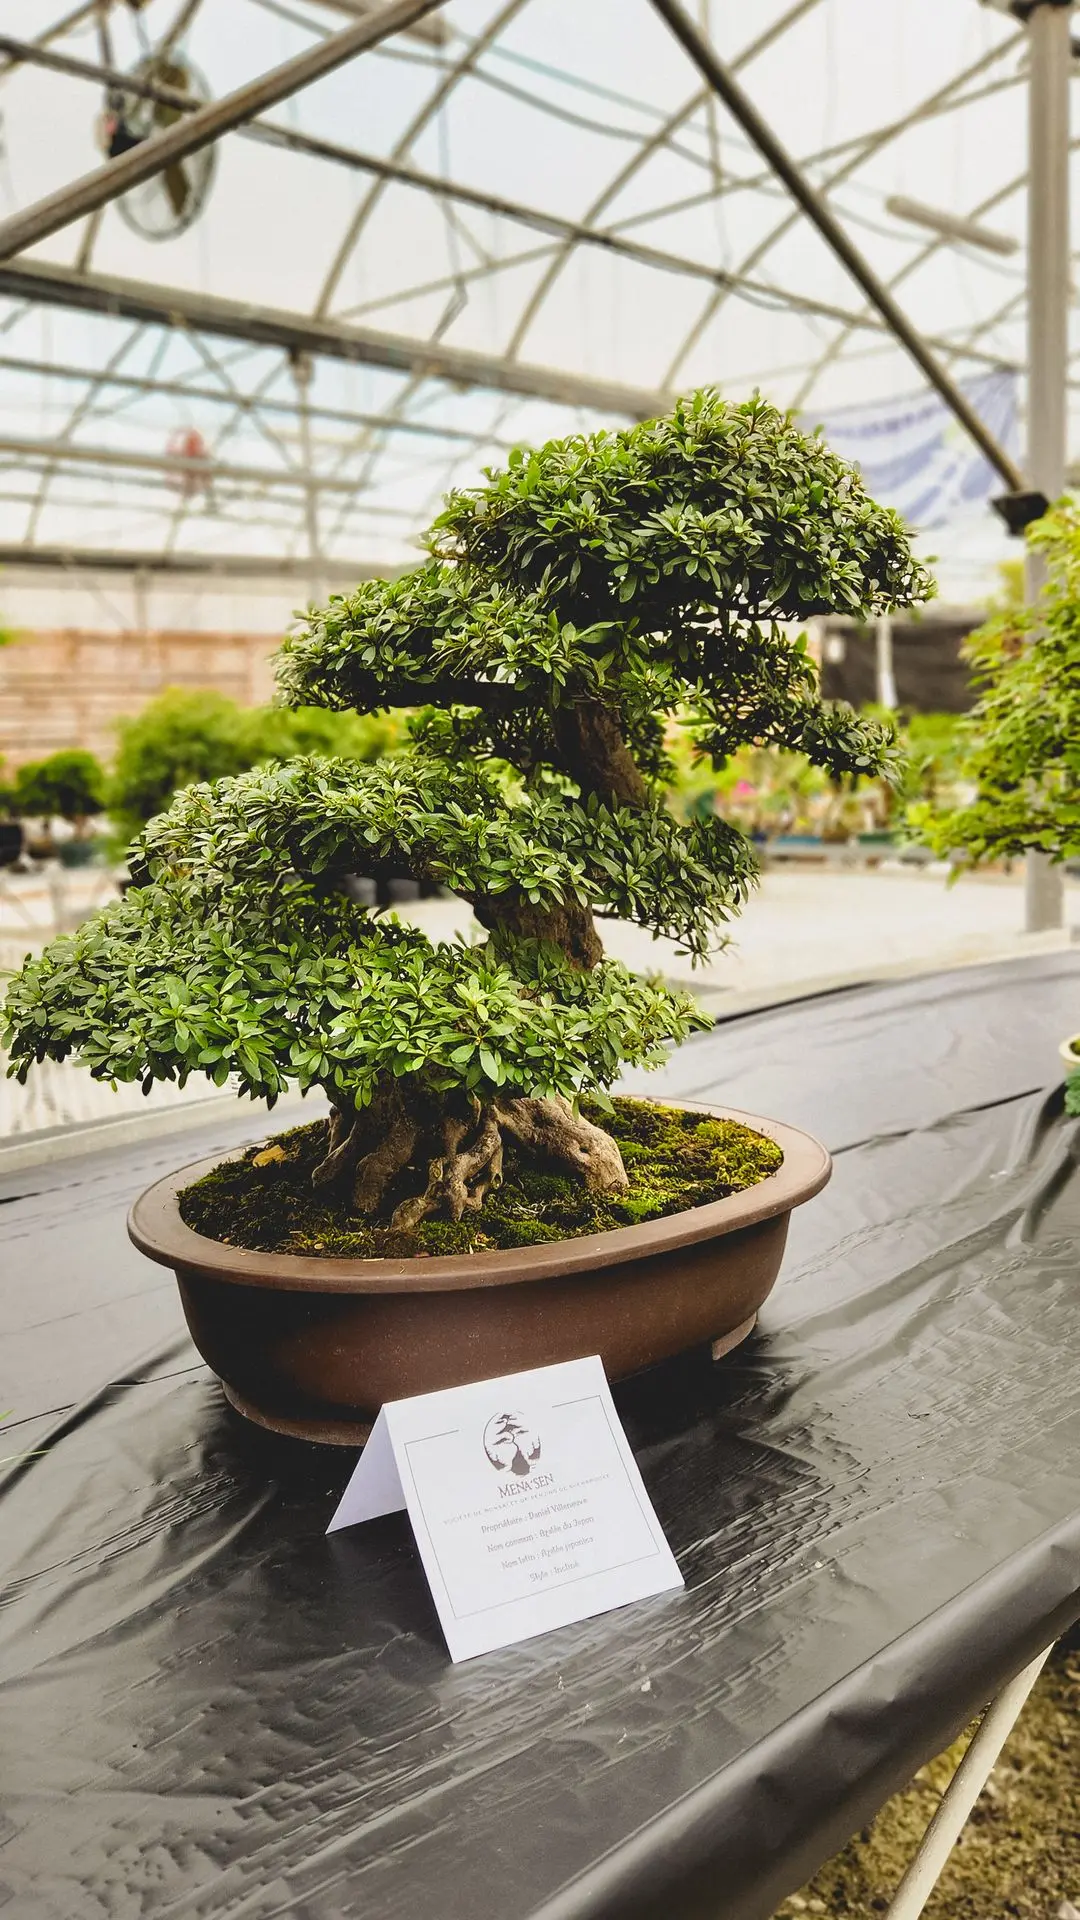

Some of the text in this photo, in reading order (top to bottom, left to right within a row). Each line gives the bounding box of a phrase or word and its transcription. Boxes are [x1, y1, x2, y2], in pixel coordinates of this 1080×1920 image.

[528, 1509, 550, 1520] Daniel
[487, 1543, 503, 1552] Nom
[562, 1522, 572, 1531] du
[502, 1559, 518, 1570] Nom
